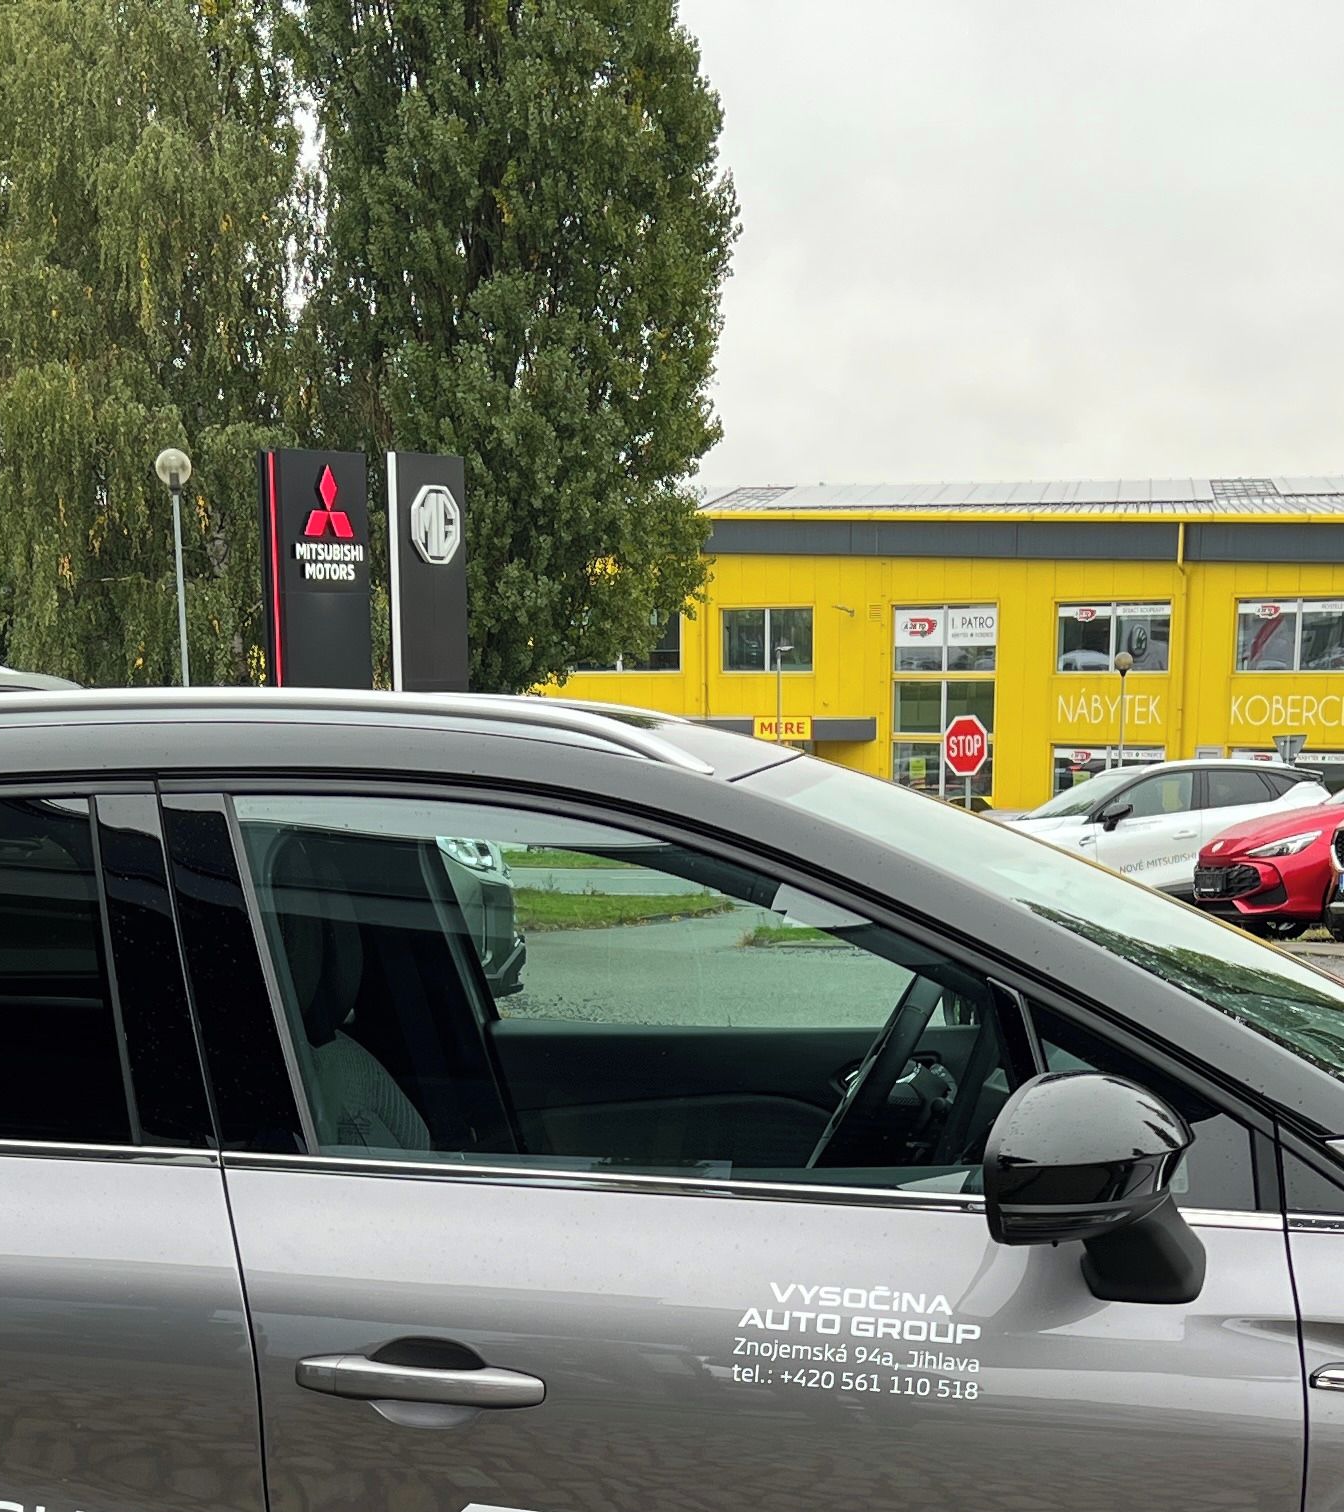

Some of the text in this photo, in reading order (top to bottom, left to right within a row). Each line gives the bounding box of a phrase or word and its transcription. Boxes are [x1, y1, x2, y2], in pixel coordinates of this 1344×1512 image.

[295, 542, 364, 562] MITSUBISHI
[305, 563, 356, 581] MOTORS
[961, 616, 995, 630] PATRO
[1057, 687, 1162, 725] NÁBYTEK
[759, 721, 806, 735] MERE
[948, 734, 982, 758] STOP
[1119, 860, 1144, 874] NOVÉ
[738, 1307, 981, 1344] AUTO GROUP
[732, 1337, 980, 1373] Znojemská 94a, Jihlava
[732, 1364, 979, 1400] tel.: +420 561 110 518
